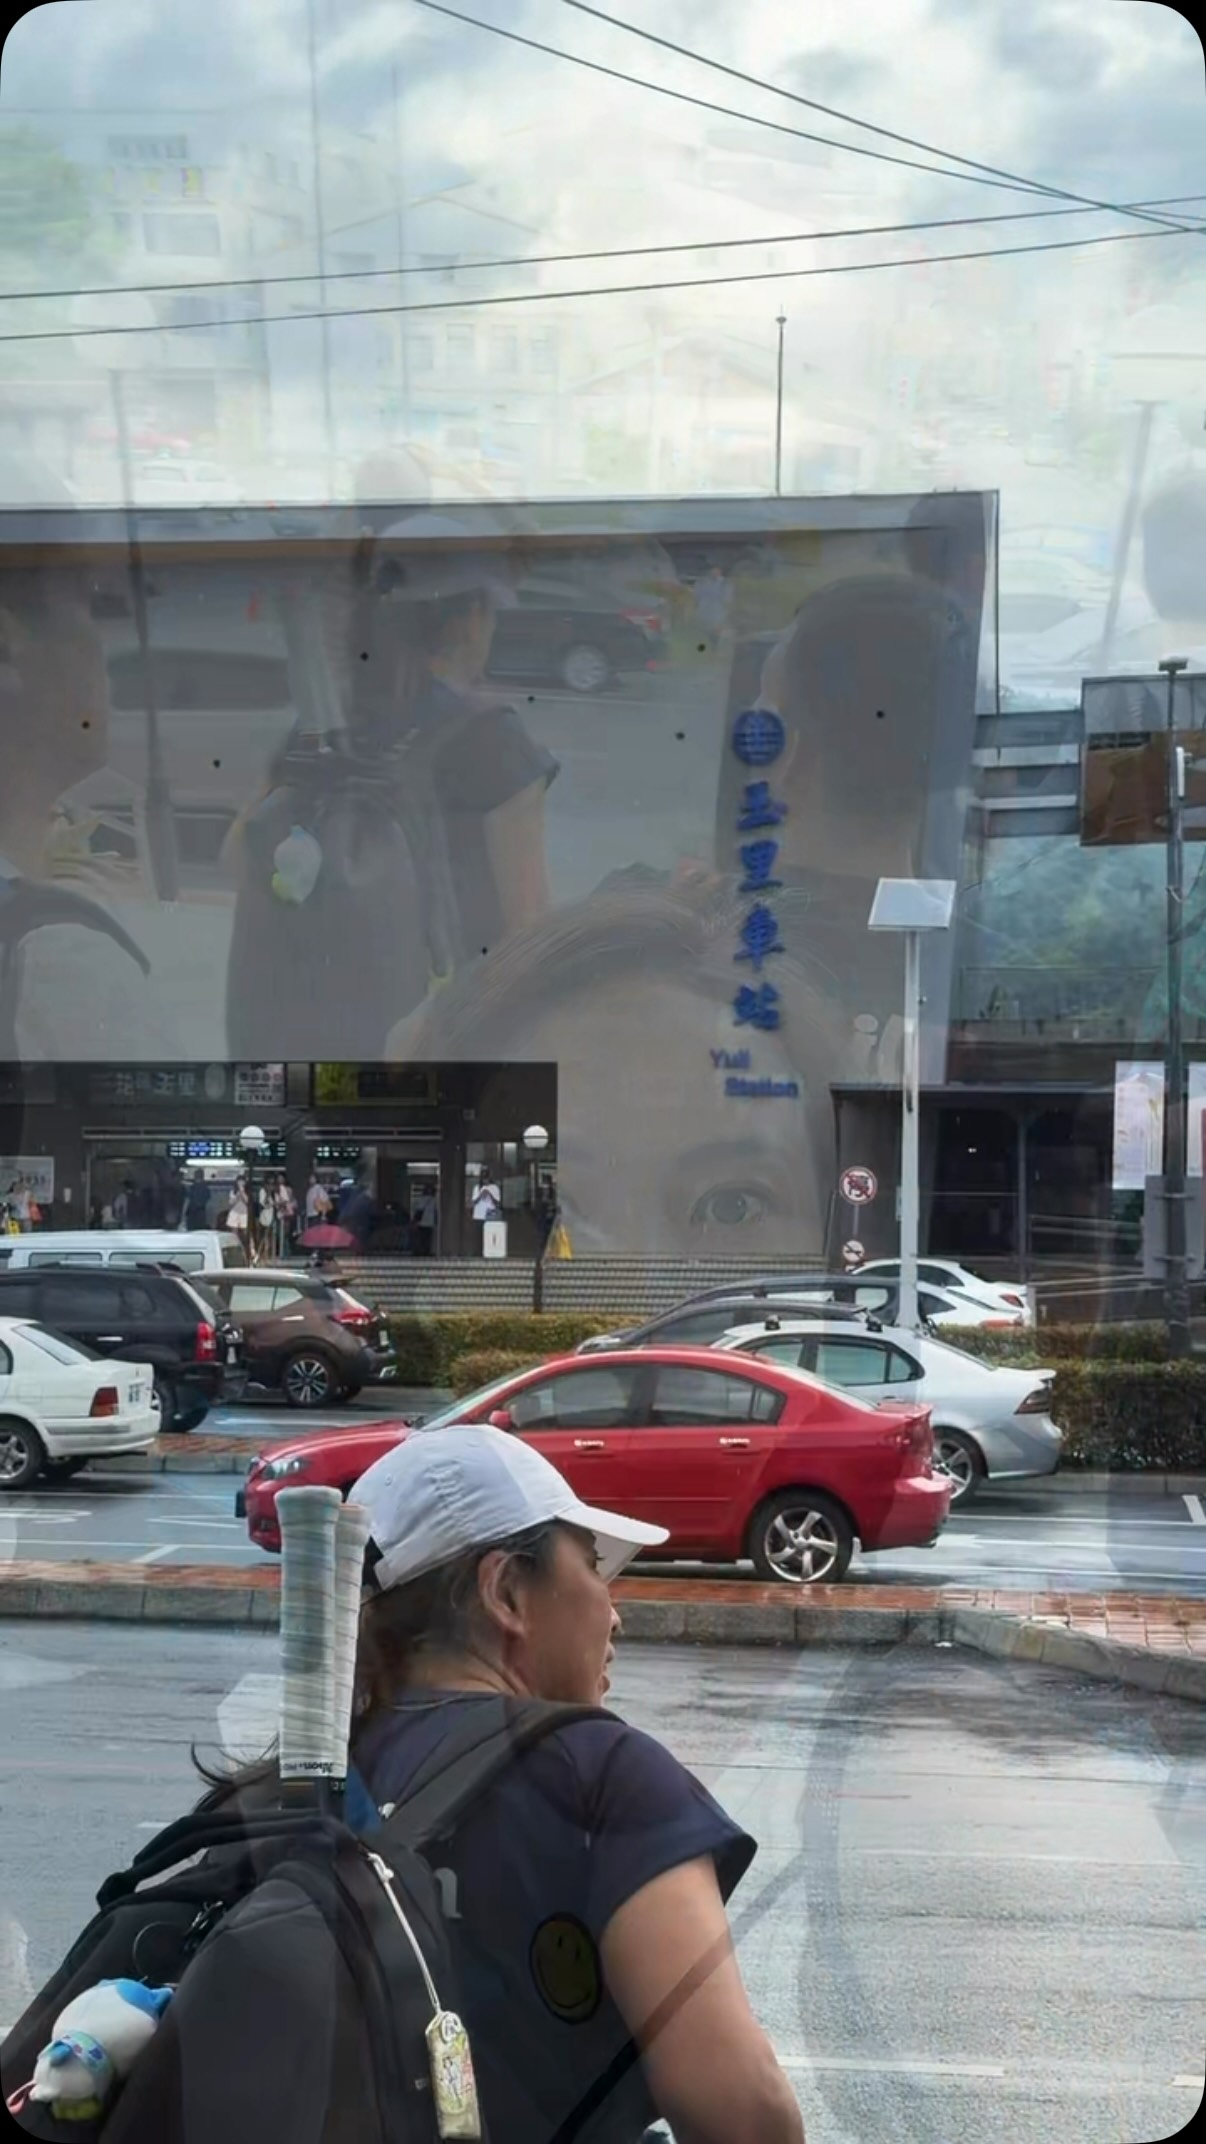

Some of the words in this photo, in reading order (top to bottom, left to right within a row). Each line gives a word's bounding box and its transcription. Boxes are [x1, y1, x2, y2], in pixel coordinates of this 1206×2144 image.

[733, 780, 788, 1031] 玉里車站
[709, 1047, 751, 1070] Yuli
[724, 1077, 799, 1099] Station
